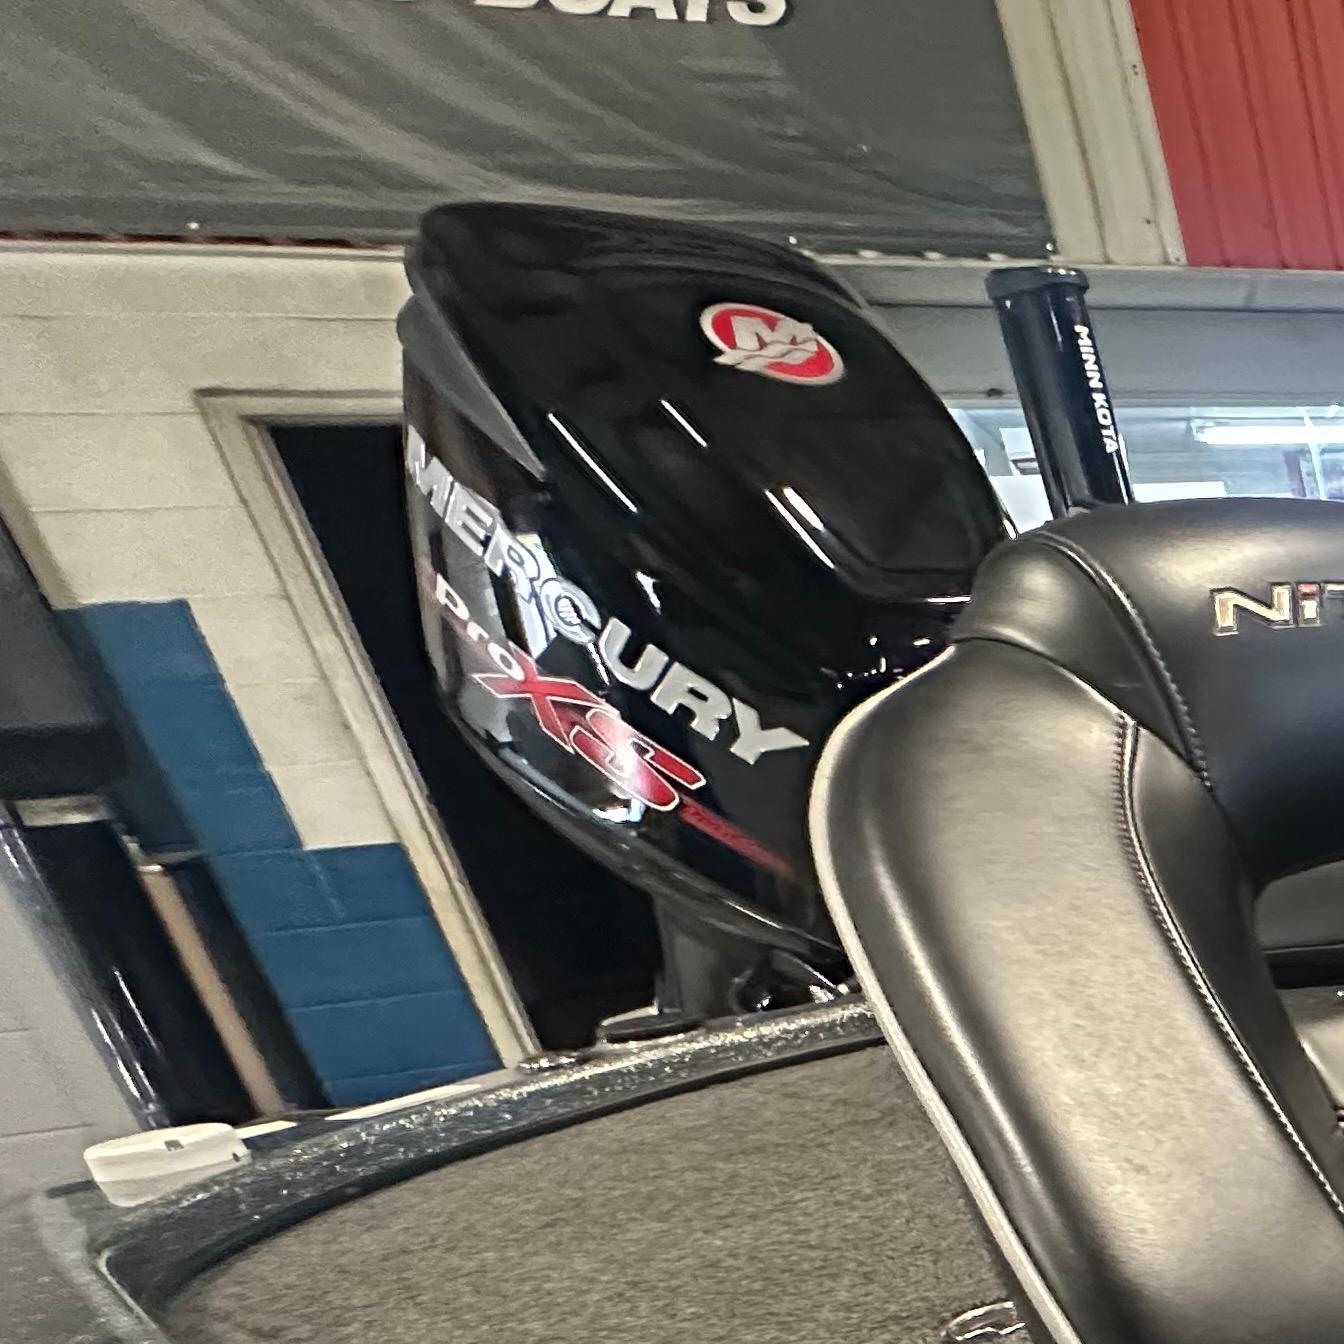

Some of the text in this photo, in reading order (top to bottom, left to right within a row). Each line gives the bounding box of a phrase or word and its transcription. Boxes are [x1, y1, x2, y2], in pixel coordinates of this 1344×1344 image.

[1073, 324, 1119, 454] MINN KOTA
[405, 424, 810, 766] MERCURY
